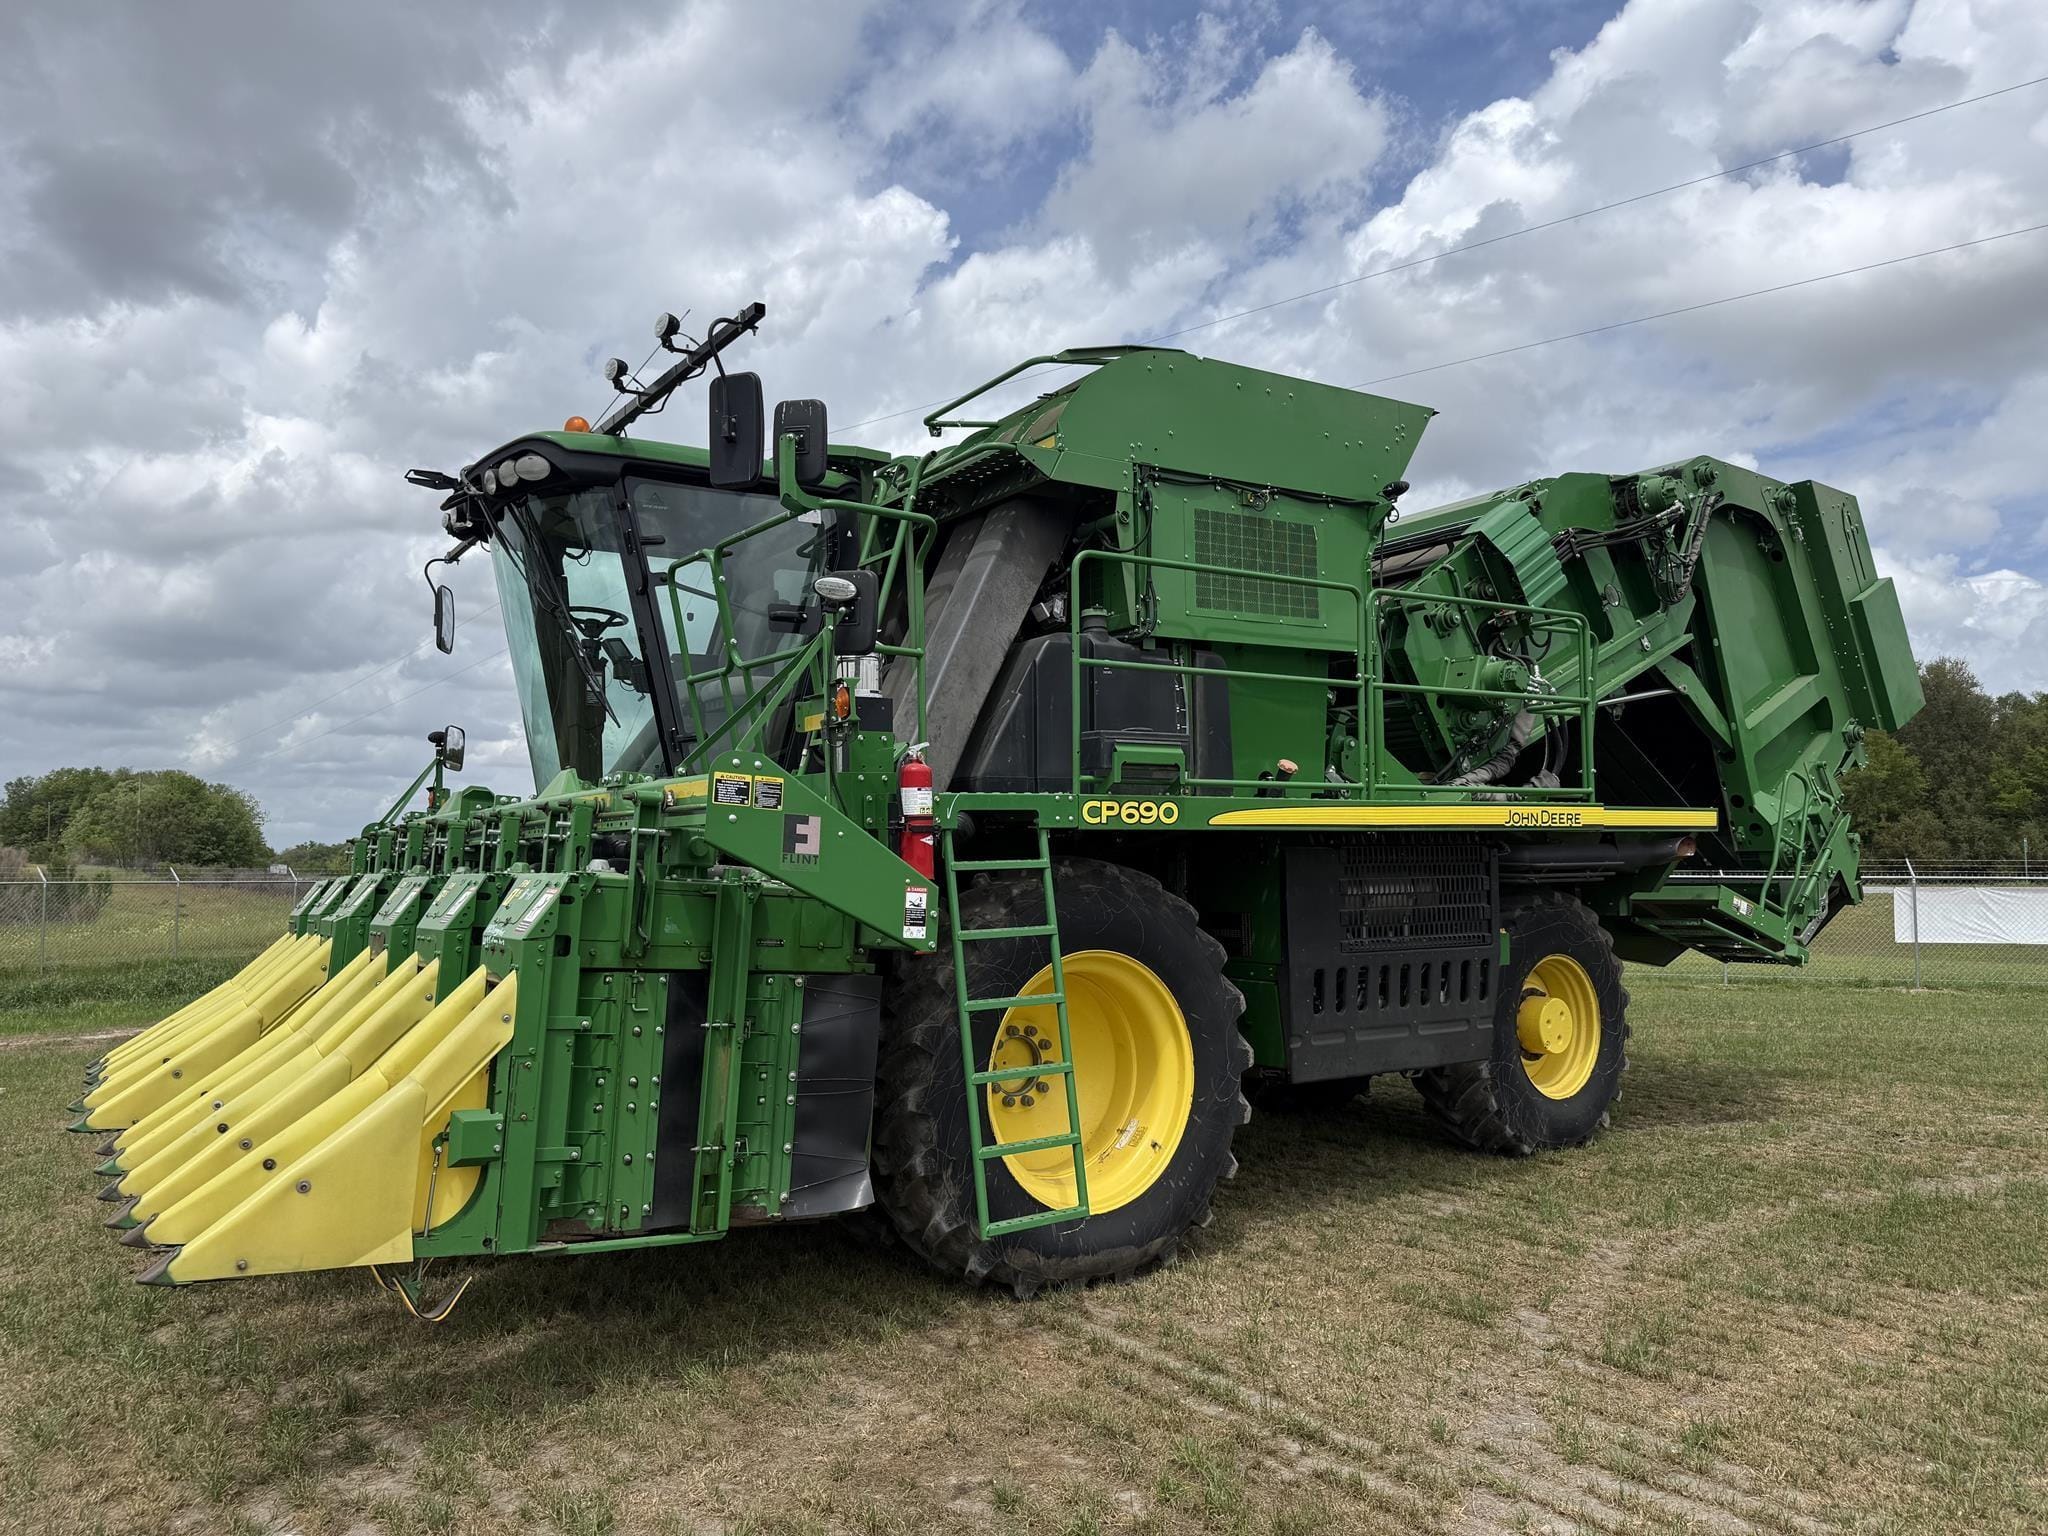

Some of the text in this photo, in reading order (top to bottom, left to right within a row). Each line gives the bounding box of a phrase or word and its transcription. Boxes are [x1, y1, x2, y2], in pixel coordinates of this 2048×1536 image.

[1082, 800, 1179, 825] CP690
[1504, 809, 1582, 825] JOHN DEERE
[782, 854, 819, 865] FLINT
